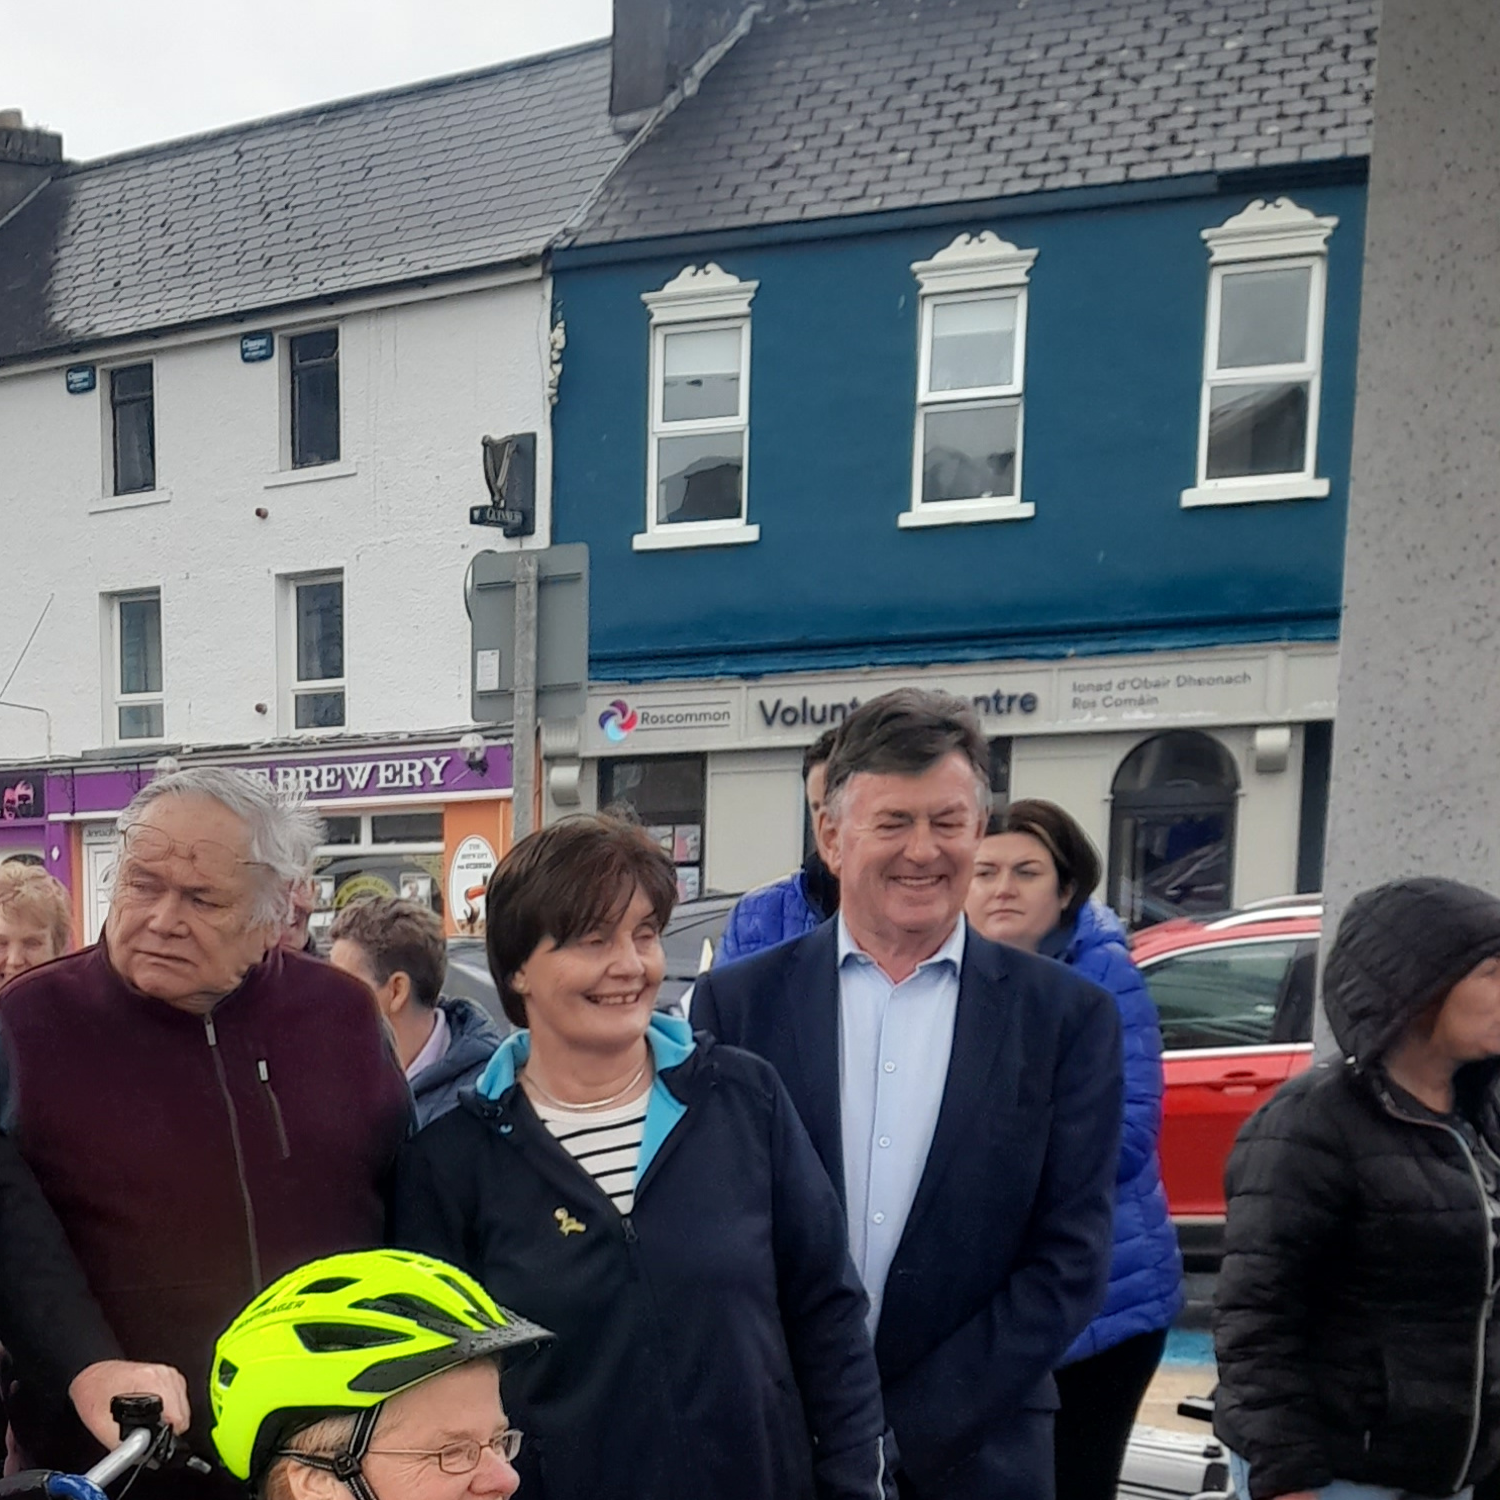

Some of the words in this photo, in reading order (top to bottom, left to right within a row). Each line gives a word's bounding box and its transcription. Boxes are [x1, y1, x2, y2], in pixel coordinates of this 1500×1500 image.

[1072, 680, 1113, 693] Ionad
[973, 688, 1038, 714] ntre
[1072, 696, 1097, 710] Ros
[641, 709, 731, 726] Roscommon
[275, 756, 451, 794] BREWERY
